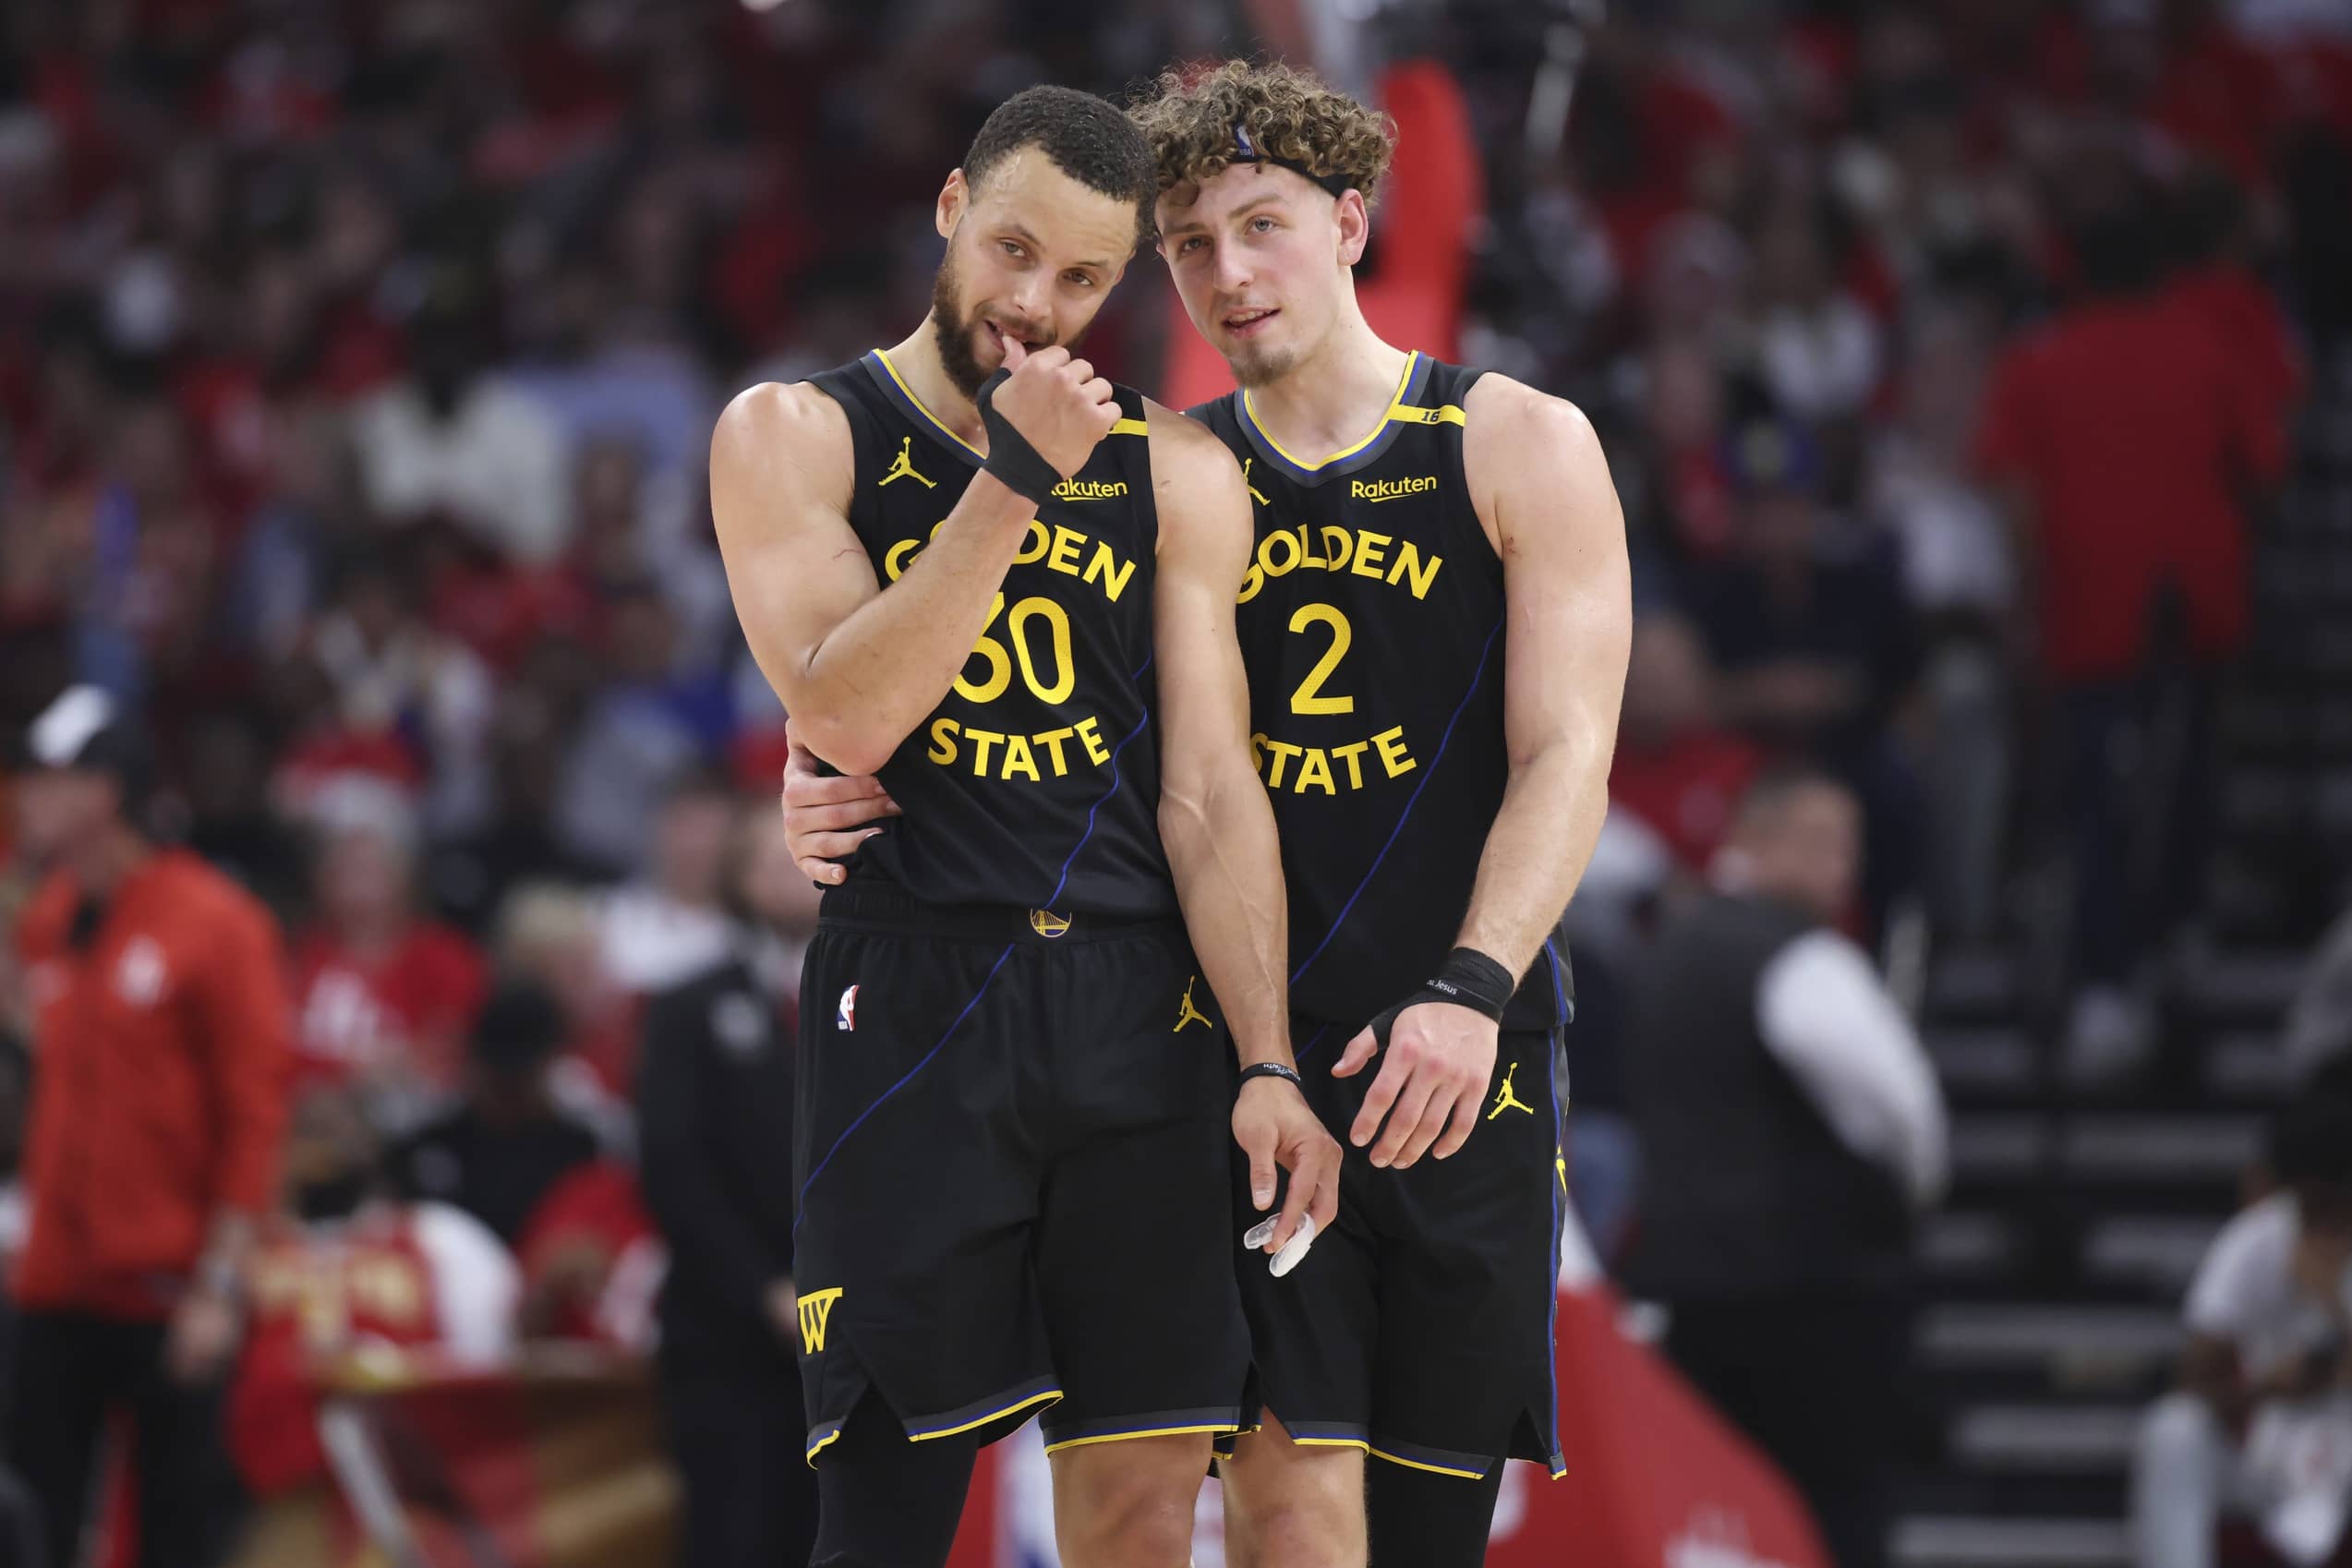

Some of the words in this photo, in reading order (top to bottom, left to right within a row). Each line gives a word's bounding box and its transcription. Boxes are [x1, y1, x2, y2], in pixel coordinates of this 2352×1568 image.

[1421, 411, 1441, 422] 16
[1051, 477, 1128, 497] akuten
[1351, 476, 1437, 498] Rakuten
[885, 519, 1137, 603] GDEN
[1288, 603, 1354, 715] 2
[927, 716, 1111, 781] STATE
[1435, 980, 1457, 995] Jesus
